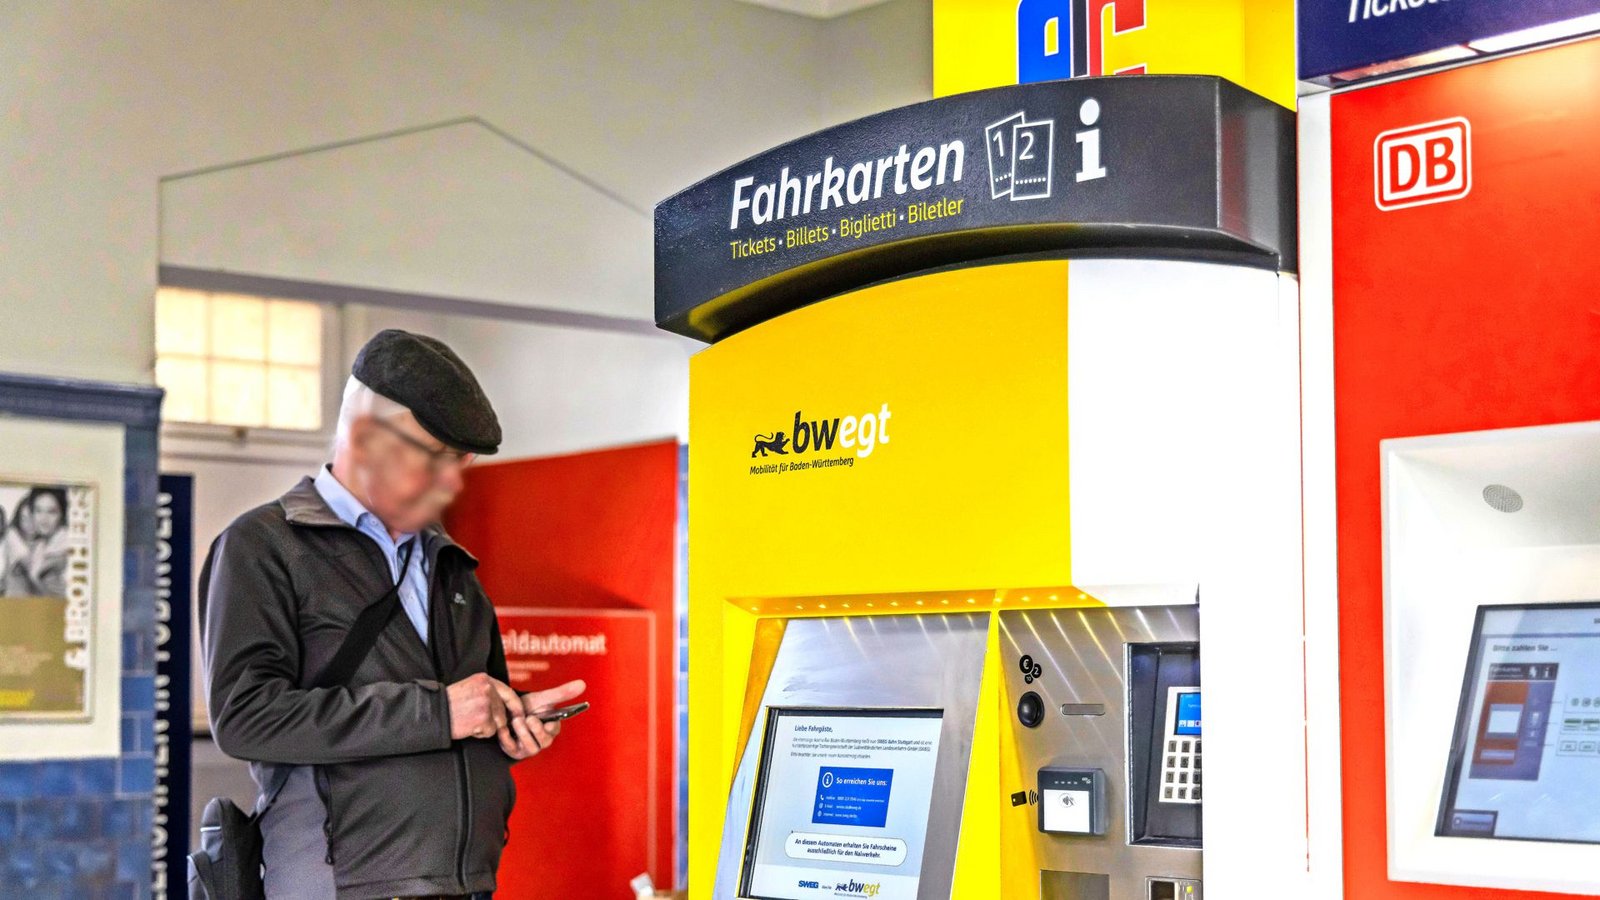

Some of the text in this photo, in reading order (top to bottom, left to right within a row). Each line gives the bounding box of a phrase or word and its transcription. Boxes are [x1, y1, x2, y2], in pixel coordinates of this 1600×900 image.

[993, 130, 1004, 157] 1
[1019, 131, 1034, 160] 2
[1388, 136, 1456, 194] DB
[729, 139, 965, 230] Fahrkarten
[730, 197, 964, 260] Tickets Billets Biglietti Biletler
[792, 403, 891, 458] bwegt
[750, 457, 854, 475] Mobilität für Baden-Württemberg
[502, 629, 607, 655] eldautomat
[808, 725, 834, 733] Fahrgäste,
[818, 840, 842, 848] Automaten
[843, 841, 862, 849] erhalten
[870, 843, 897, 851] Fahrscheine
[798, 880, 819, 889] SWEG
[848, 878, 881, 897] bwegt
